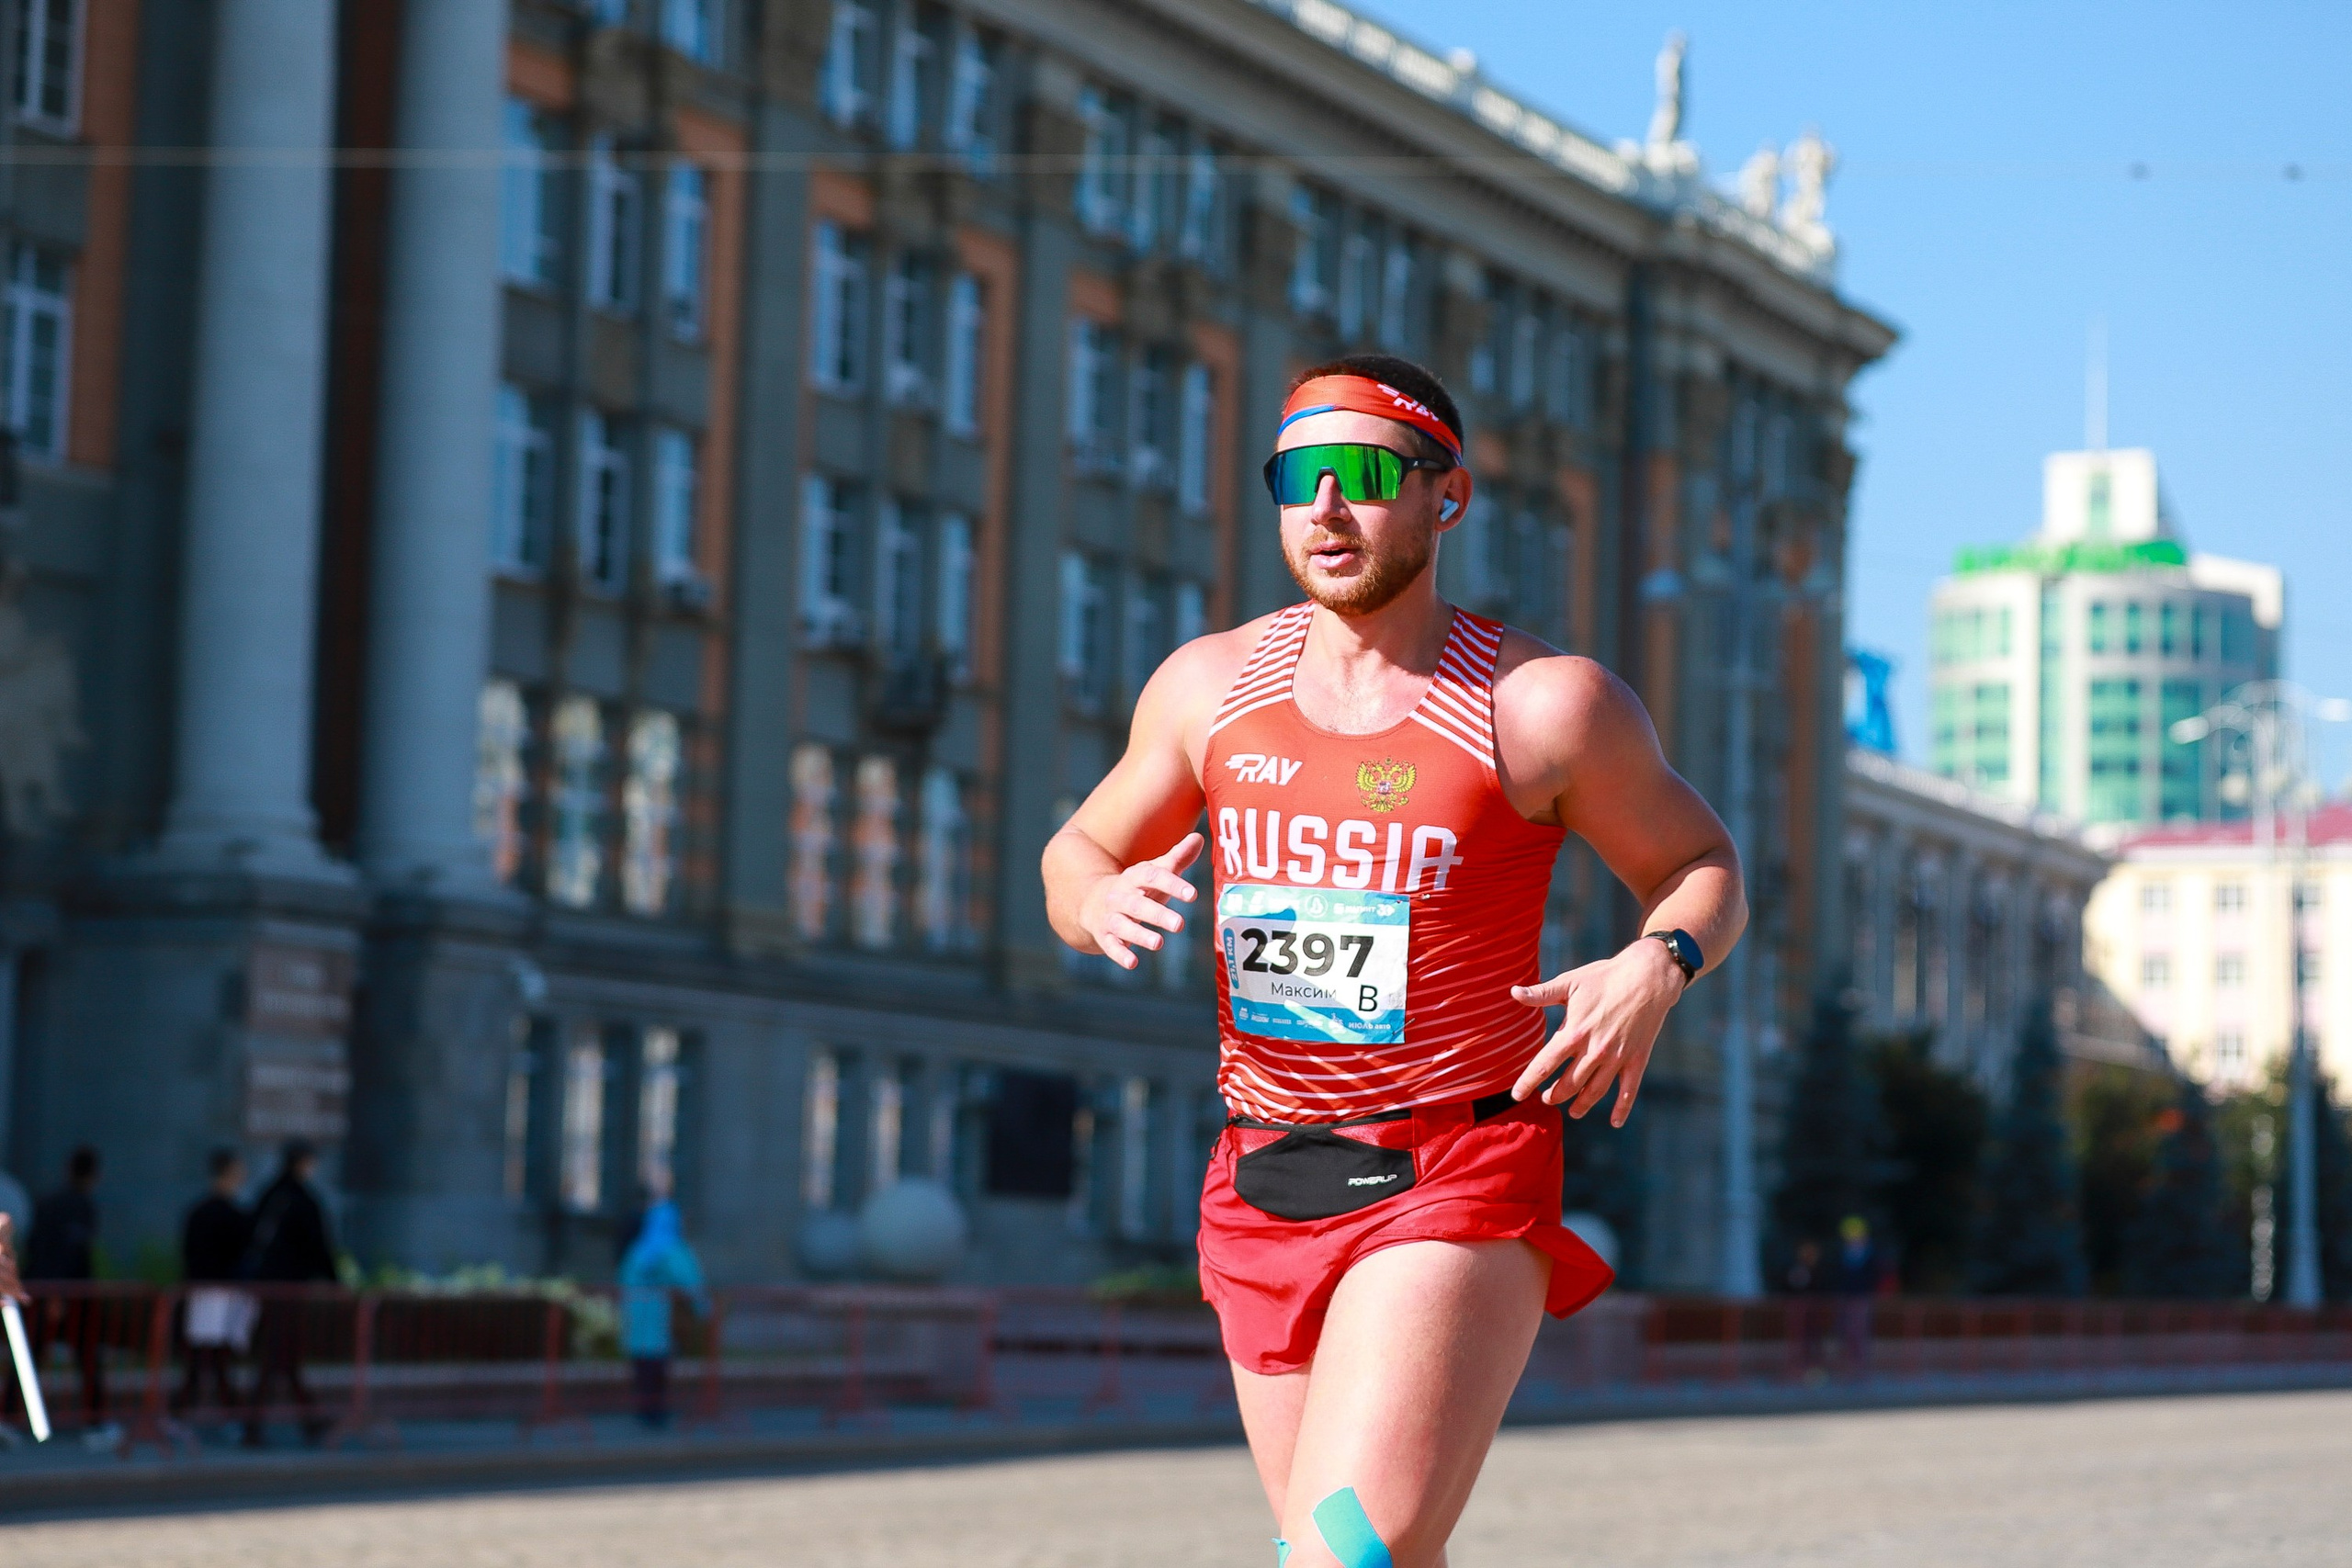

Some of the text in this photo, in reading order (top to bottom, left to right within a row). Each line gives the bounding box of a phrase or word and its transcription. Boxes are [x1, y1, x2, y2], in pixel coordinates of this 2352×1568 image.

[1225, 753, 1303, 786] RAY
[1218, 807, 1464, 892] RUSSIA
[1240, 928, 1374, 978] 2397
[1272, 982, 1337, 999] Максим
[1348, 1174, 1397, 1187] POWERUP
